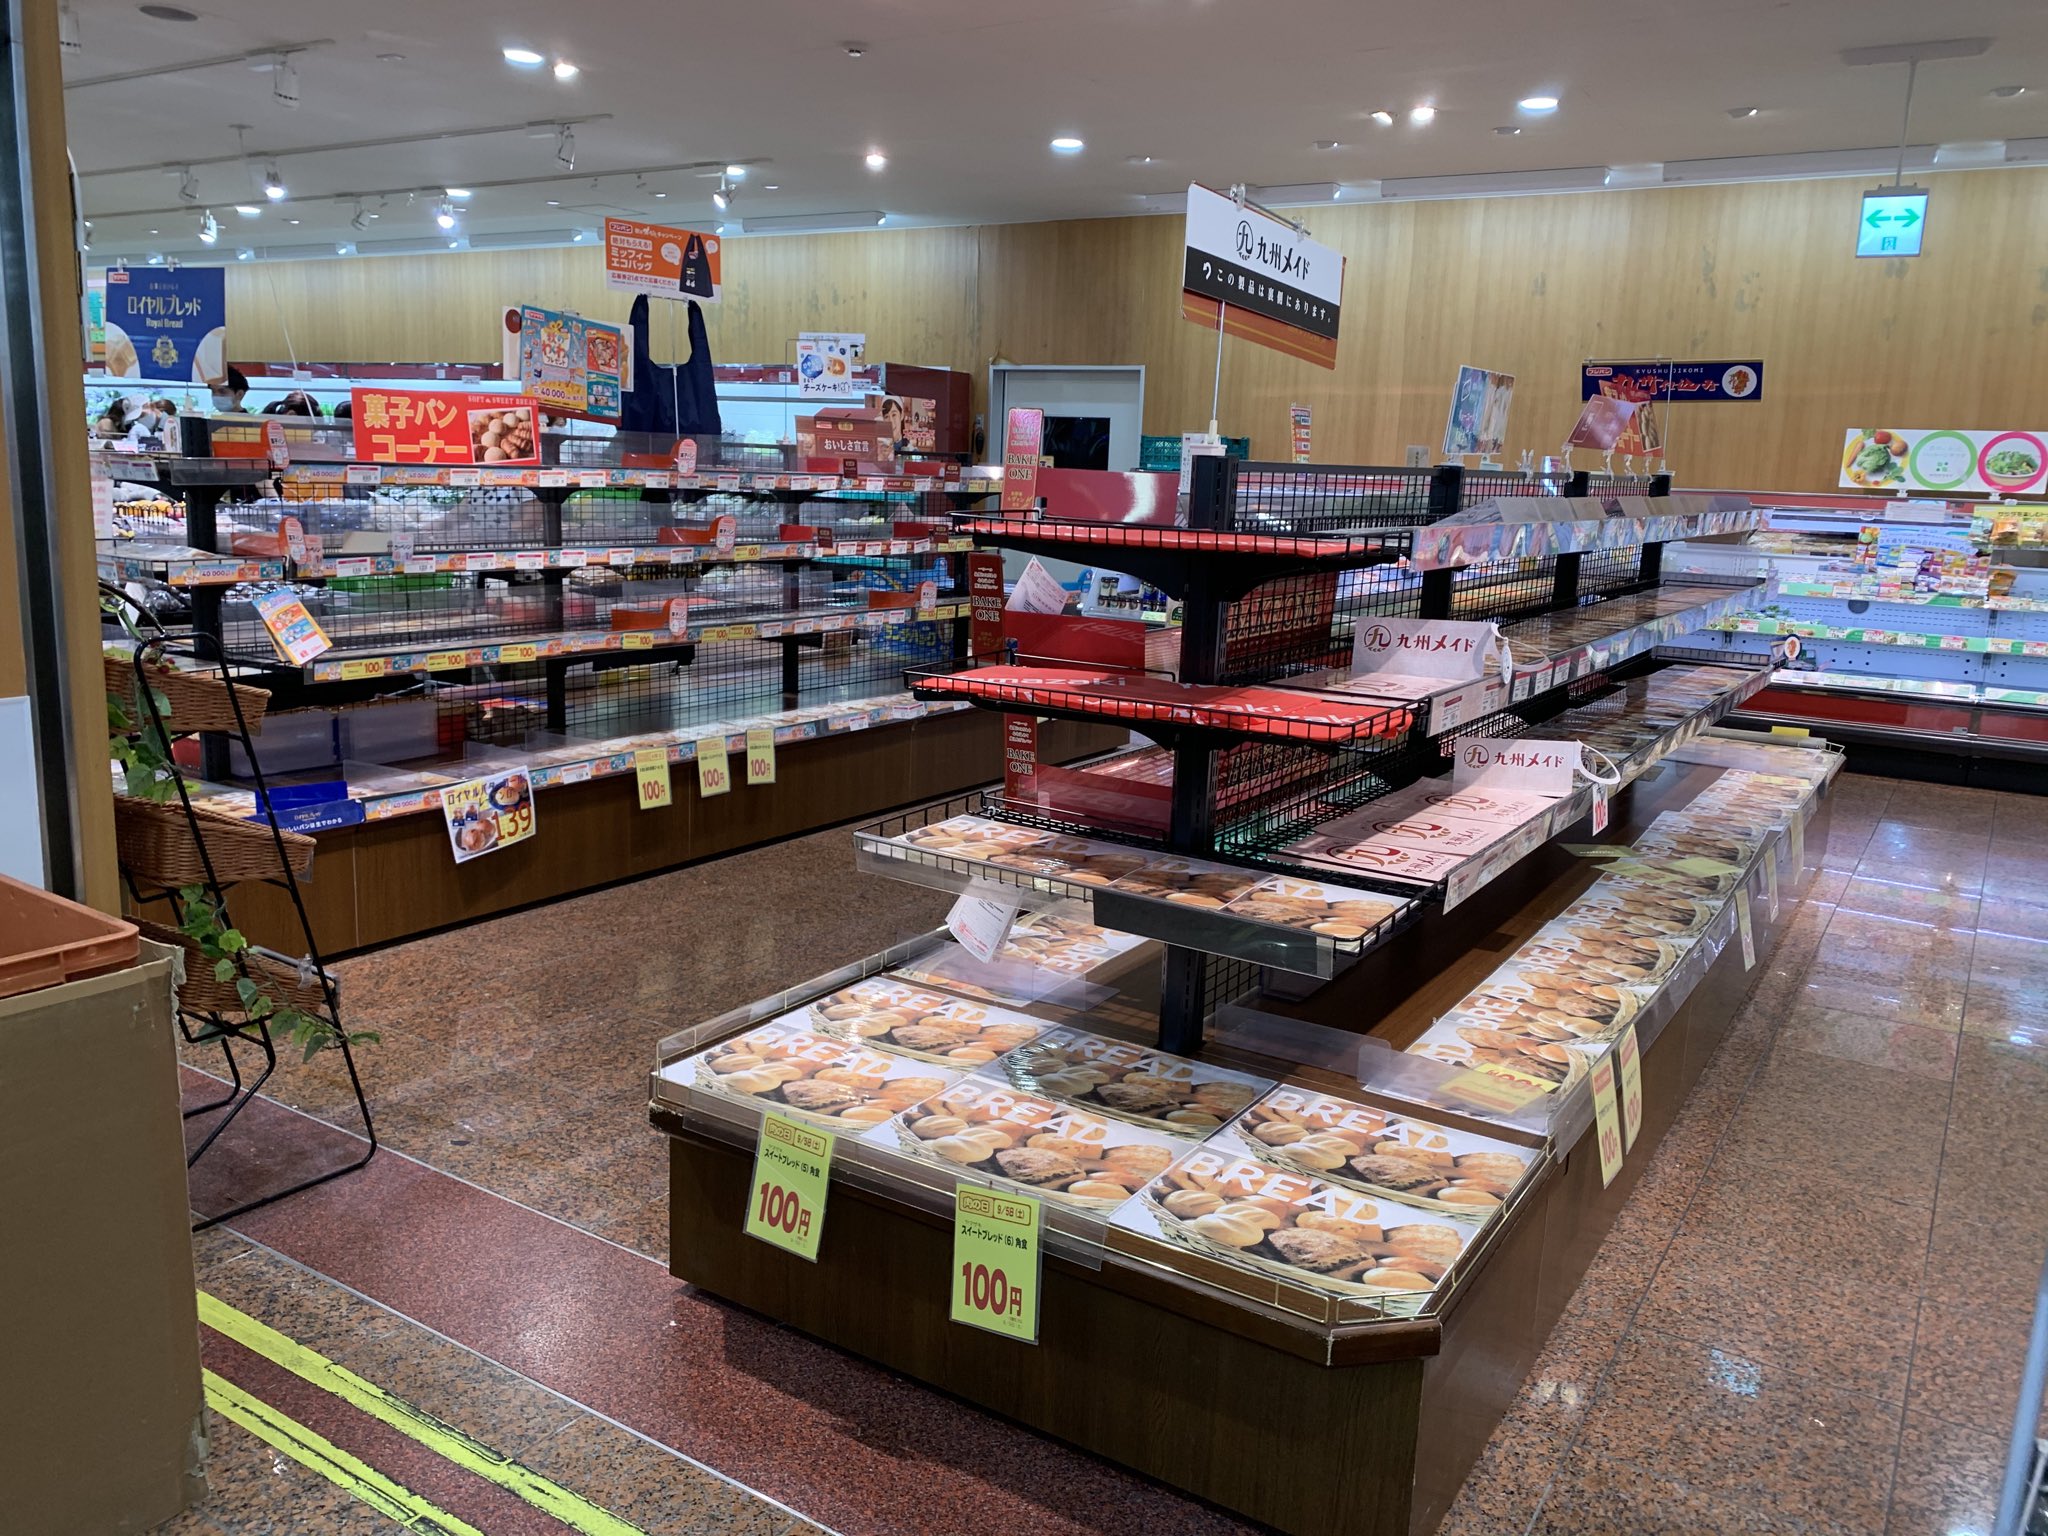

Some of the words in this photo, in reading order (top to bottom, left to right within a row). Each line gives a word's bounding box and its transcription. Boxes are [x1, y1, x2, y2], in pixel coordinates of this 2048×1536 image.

[611, 247, 652, 261] ミッフィー
[611, 257, 652, 272] エコバッグ
[1257, 236, 1310, 280] 九州メイド
[128, 294, 202, 317] ロイヤルブレッド
[1217, 268, 1331, 323] この製品は裏側にあります。
[146, 318, 164, 329] Royal
[804, 383, 841, 392] チーズケーキ!
[362, 394, 458, 429] 菓子パン
[468, 395, 484, 404] SOFT
[492, 396, 514, 405] SWEET
[371, 431, 468, 464] コーナー
[824, 439, 870, 453] おいしさ宣言
[1007, 453, 1037, 465] BAKE
[1008, 467, 1033, 480] ONE
[972, 596, 1002, 608] BAKE
[976, 610, 1000, 622] ONE
[1397, 634, 1476, 653] 九州メイド
[1007, 748, 1035, 762] BAKE
[1494, 751, 1565, 768] 九州メイド
[1010, 762, 1034, 775] ONE
[491, 802, 531, 841] 139
[940, 819, 1092, 854] BREAD
[849, 979, 990, 1026] BREAD
[1454, 985, 1537, 1031] BREAD
[744, 1025, 896, 1079] BREAD
[1038, 1030, 1199, 1084] BREAD
[943, 1083, 1111, 1146] BREAD
[1265, 1092, 1452, 1153] BREAD
[764, 1147, 801, 1170] スイートブレッド
[1181, 1150, 1383, 1226] BREAD
[759, 1181, 812, 1237] 100円
[961, 1224, 1003, 1246] スイートブレッド
[1004, 1234, 1014, 1247] (6)
[962, 1261, 1022, 1317] 100円
